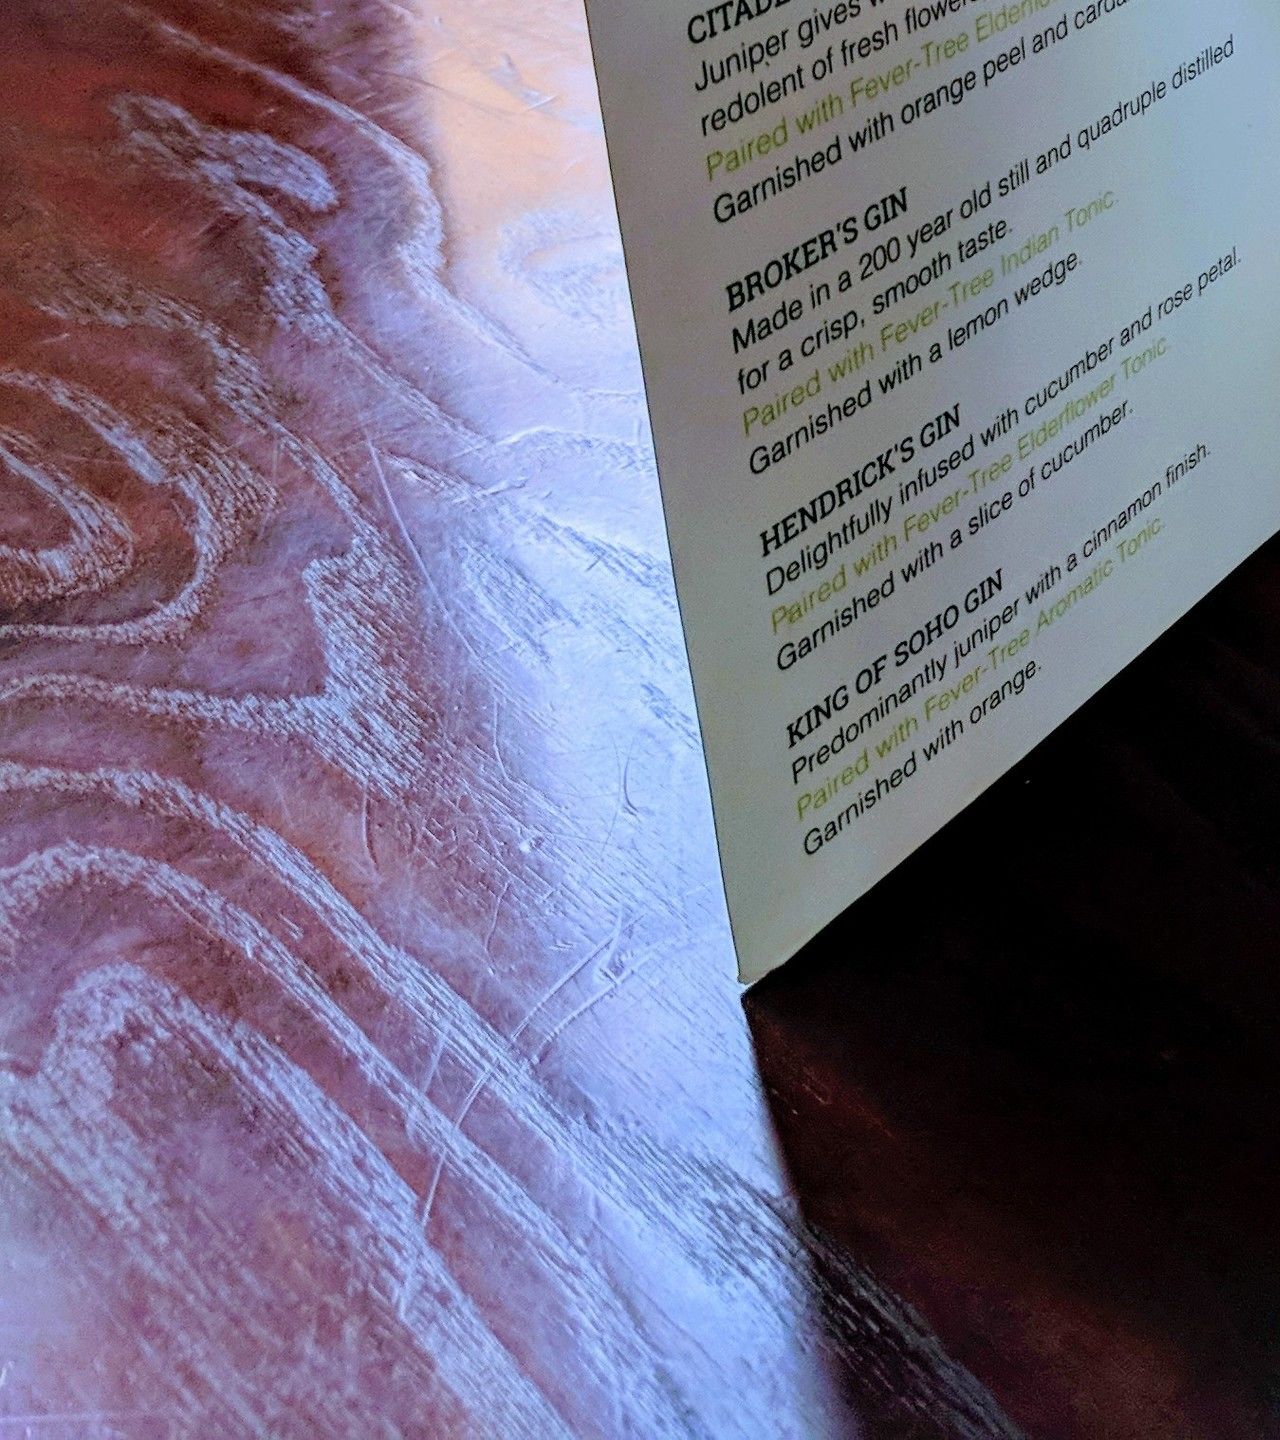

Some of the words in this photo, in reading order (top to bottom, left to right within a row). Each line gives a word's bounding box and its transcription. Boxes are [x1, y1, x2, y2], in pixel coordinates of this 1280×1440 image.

[725, 215, 859, 314] BROKER'S
[863, 186, 908, 232] GIN
[737, 359, 770, 396] for
[778, 348, 794, 372] a
[800, 310, 865, 358] crisp,
[872, 251, 952, 315] smooth
[957, 219, 1013, 263] taste.
[759, 436, 915, 558] HENDRICK'S
[919, 402, 960, 449] GIN
[776, 570, 895, 671] Garnished
[900, 541, 944, 584] with
[950, 528, 963, 550] a
[968, 491, 1013, 536] slice
[1018, 466, 1035, 498] of
[1040, 400, 1133, 481] cucumber.
[786, 684, 850, 749] KING
[855, 653, 888, 695] OF
[893, 604, 960, 668] SOHO
[963, 567, 1003, 614] GIN
[803, 750, 917, 856] Garnished
[922, 719, 964, 762] with
[969, 660, 1042, 725] orange.
